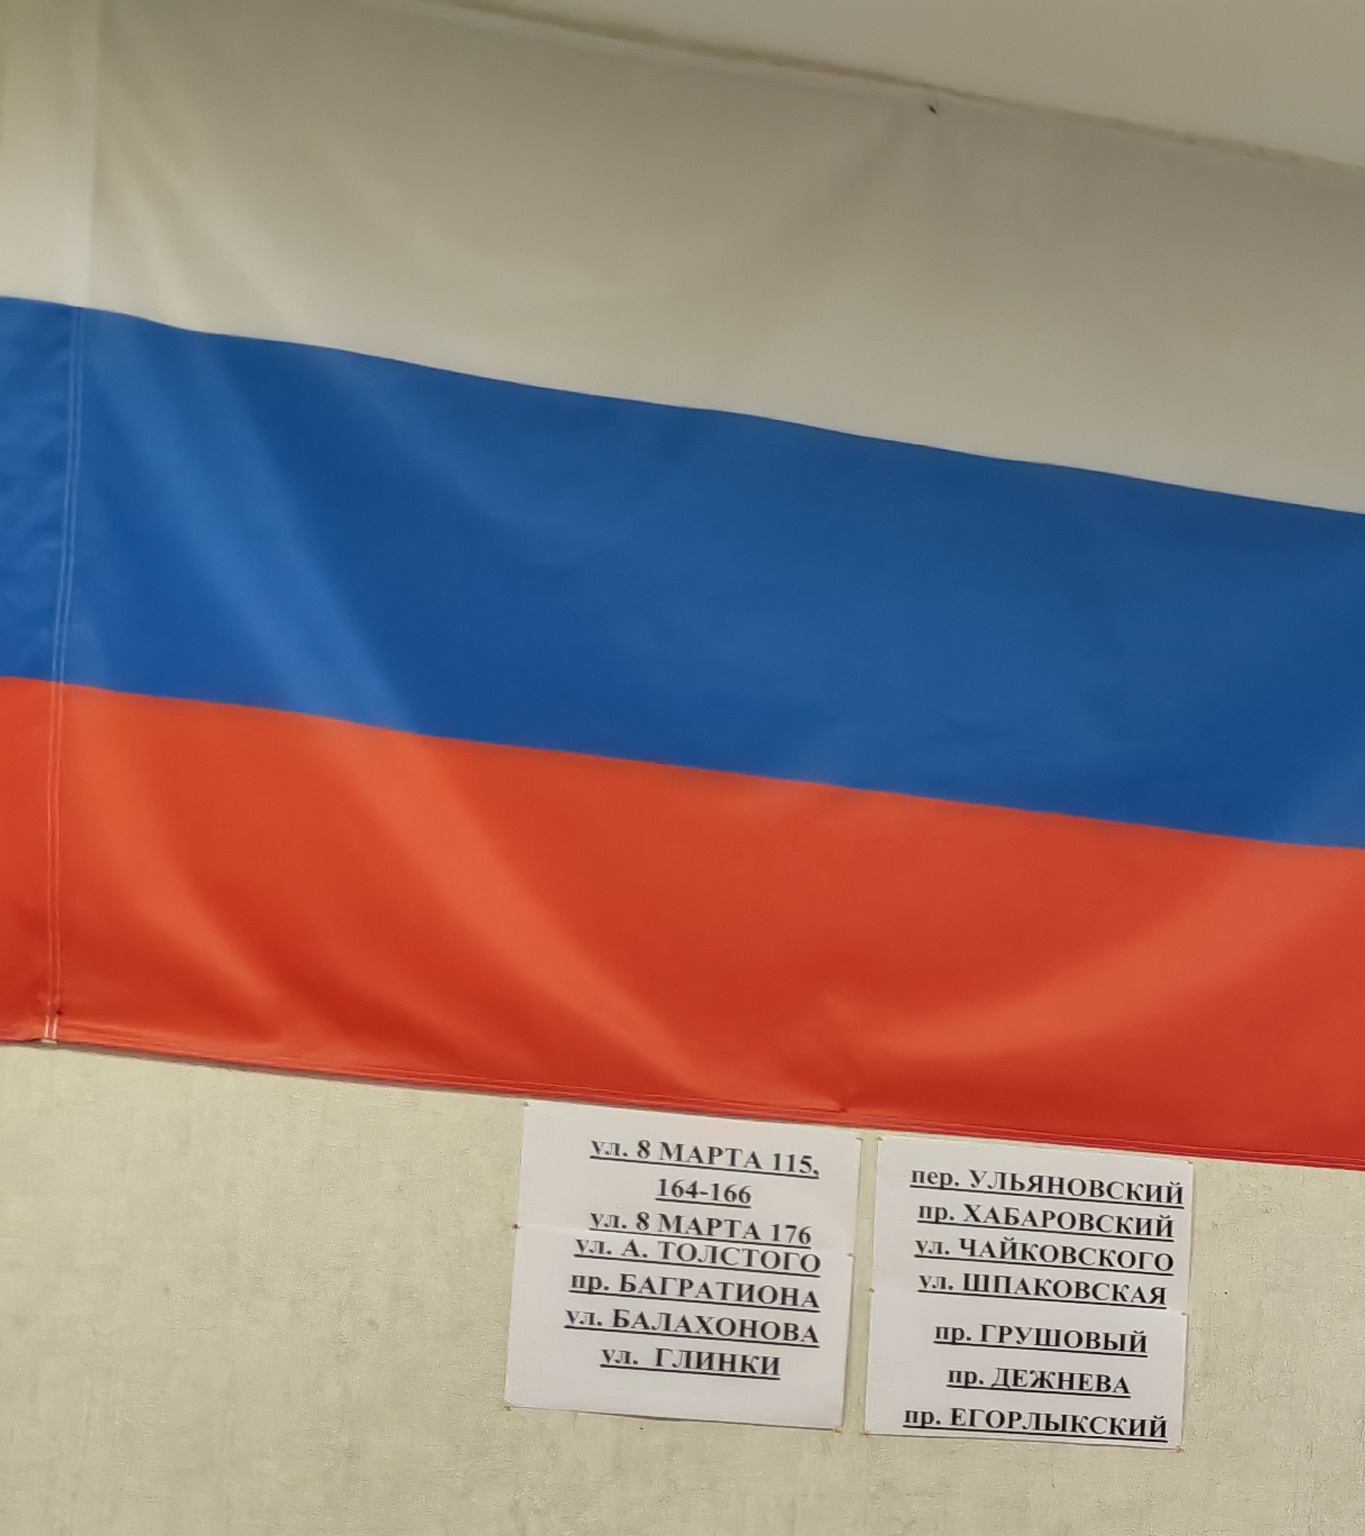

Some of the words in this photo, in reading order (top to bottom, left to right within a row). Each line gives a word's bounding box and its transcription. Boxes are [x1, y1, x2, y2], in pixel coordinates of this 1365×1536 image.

[591, 1140, 628, 1159] ул.
[636, 1139, 651, 1158] 8
[659, 1141, 762, 1170] МАРТА
[772, 1152, 819, 1175] 115,
[657, 1178, 752, 1204] 164-166
[911, 1169, 960, 1189] пер.
[968, 1169, 1185, 1205] УЛЬЯНОВСКИЙ
[591, 1212, 628, 1230] ул.
[635, 1212, 651, 1231] 8
[658, 1213, 761, 1241] МАРТА
[770, 1224, 812, 1245] 176
[918, 1204, 956, 1223] пр.
[963, 1204, 1175, 1238] ХАБАРОВСКИЙ
[575, 1238, 613, 1256] ул.
[621, 1239, 649, 1258] А.
[658, 1240, 821, 1272] ТОЛСТОГО
[915, 1239, 950, 1256] ул.
[959, 1237, 1174, 1272] ЧАЙКОВСКОГО
[570, 1274, 610, 1292] пр.
[619, 1273, 821, 1309] БАГРАТИОНА
[918, 1274, 954, 1290] ул.
[962, 1273, 1168, 1305] ШПАКОВСКАЯ
[565, 1309, 603, 1328] ул.
[612, 1308, 820, 1344] БАЛАХОНОВА
[934, 1325, 972, 1343] пр.
[980, 1324, 1148, 1353] ГРУШОВЫЙ
[601, 1348, 639, 1366] ул.
[654, 1348, 781, 1376] ГЛИНКИ
[948, 1369, 985, 1388] пр.
[991, 1368, 1131, 1394] ДЕЖНЕВА
[904, 1410, 941, 1428] пр.
[950, 1407, 1168, 1438] ЕГОРЛЫКСКИЙ
